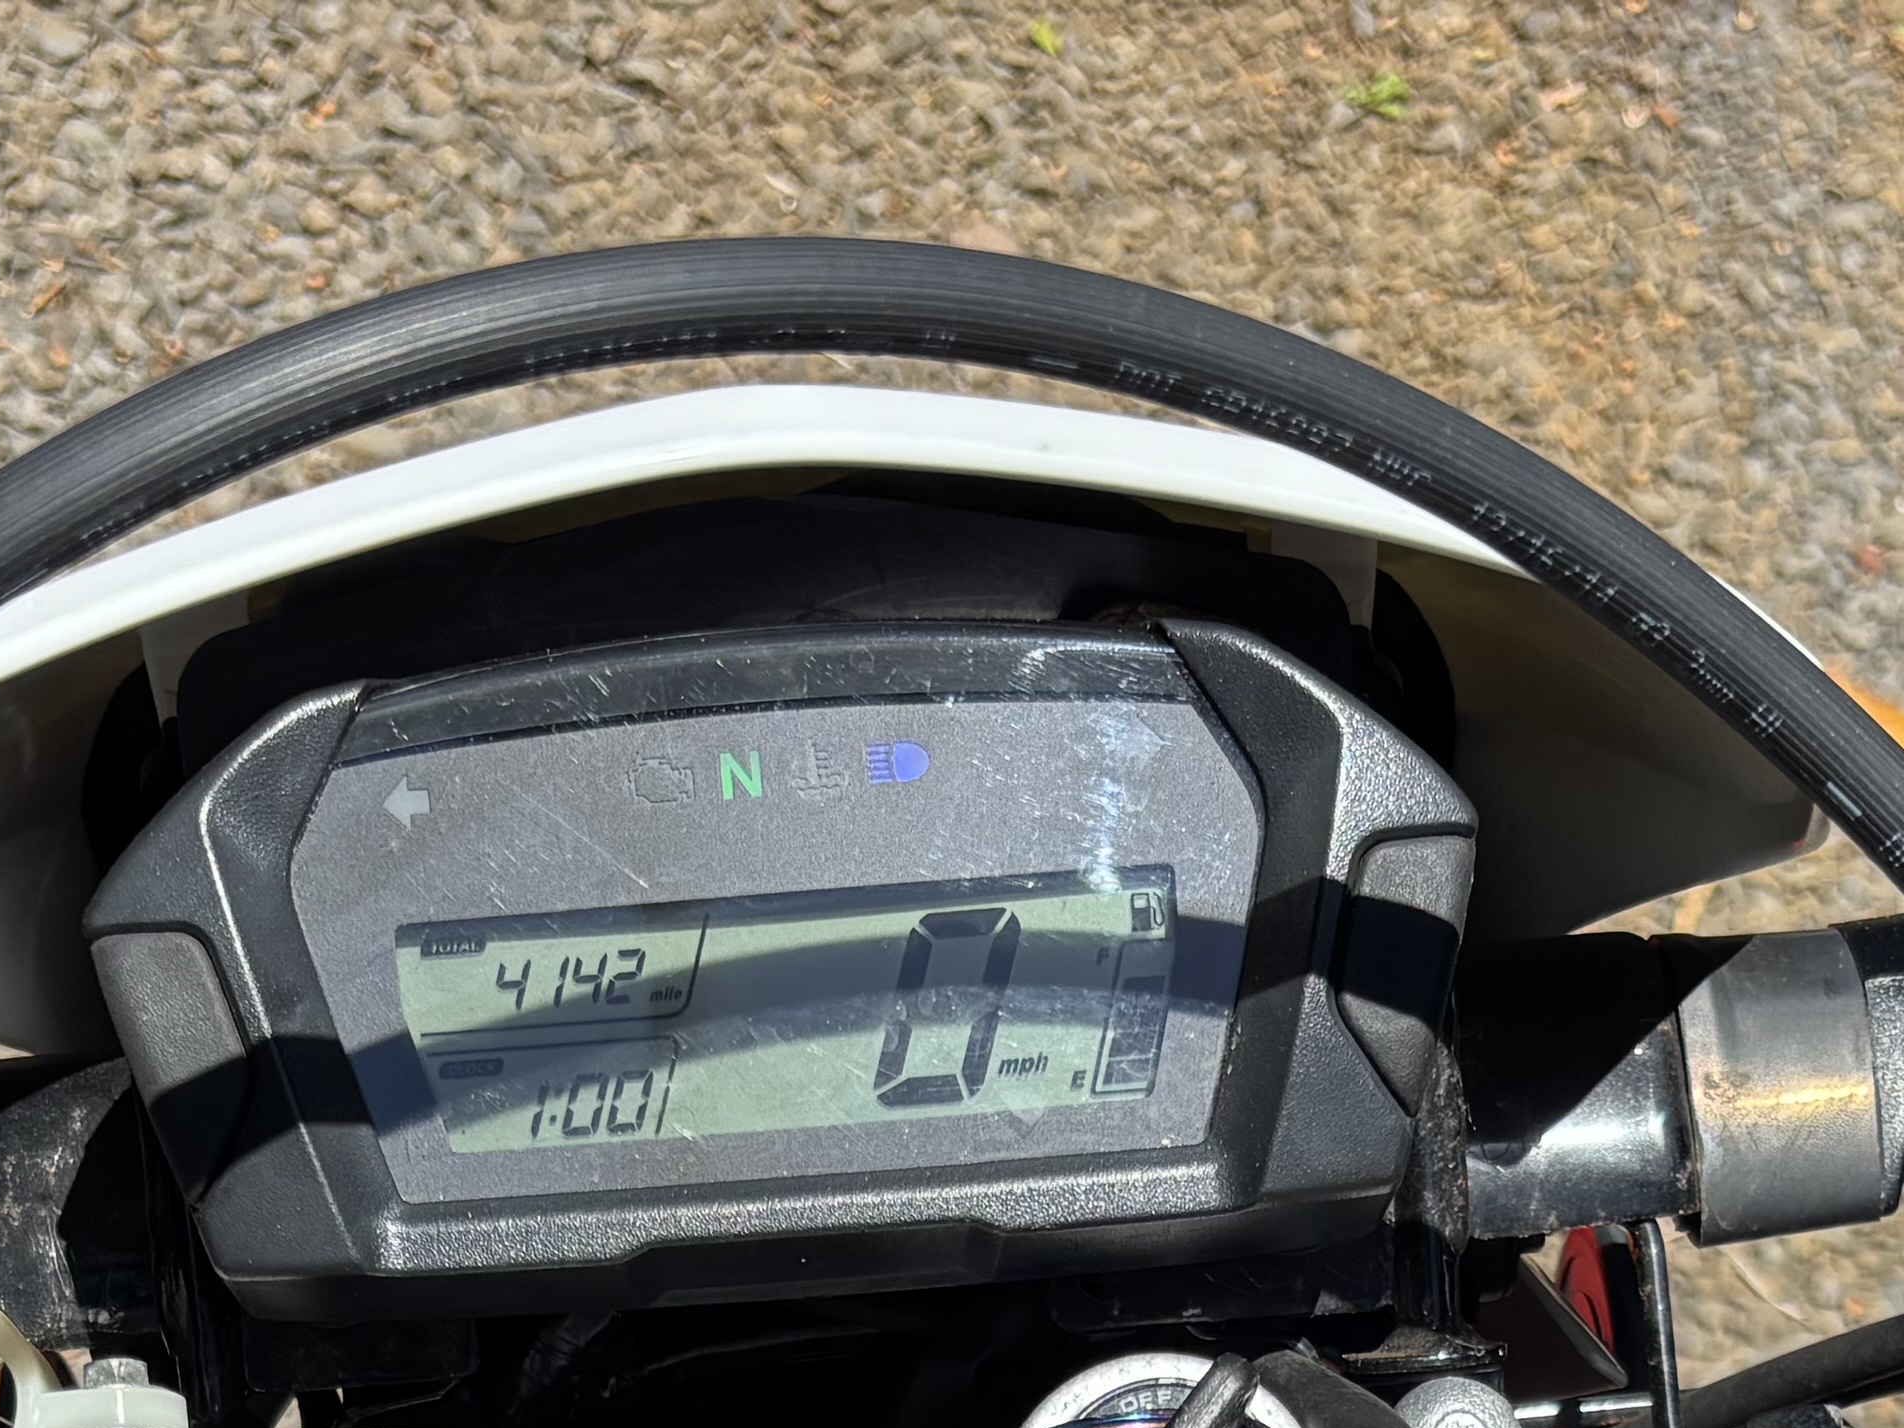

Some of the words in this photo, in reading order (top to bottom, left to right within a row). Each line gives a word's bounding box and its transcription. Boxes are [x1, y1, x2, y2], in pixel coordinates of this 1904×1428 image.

[719, 750, 764, 801] N
[496, 947, 646, 1012] 4142
[649, 986, 684, 1003] mile
[873, 906, 1023, 1110] 0
[997, 1052, 1049, 1079] mph
[531, 1070, 654, 1140] 1:00
[1071, 1069, 1087, 1090] E
[1118, 1390, 1173, 1413] OFF
